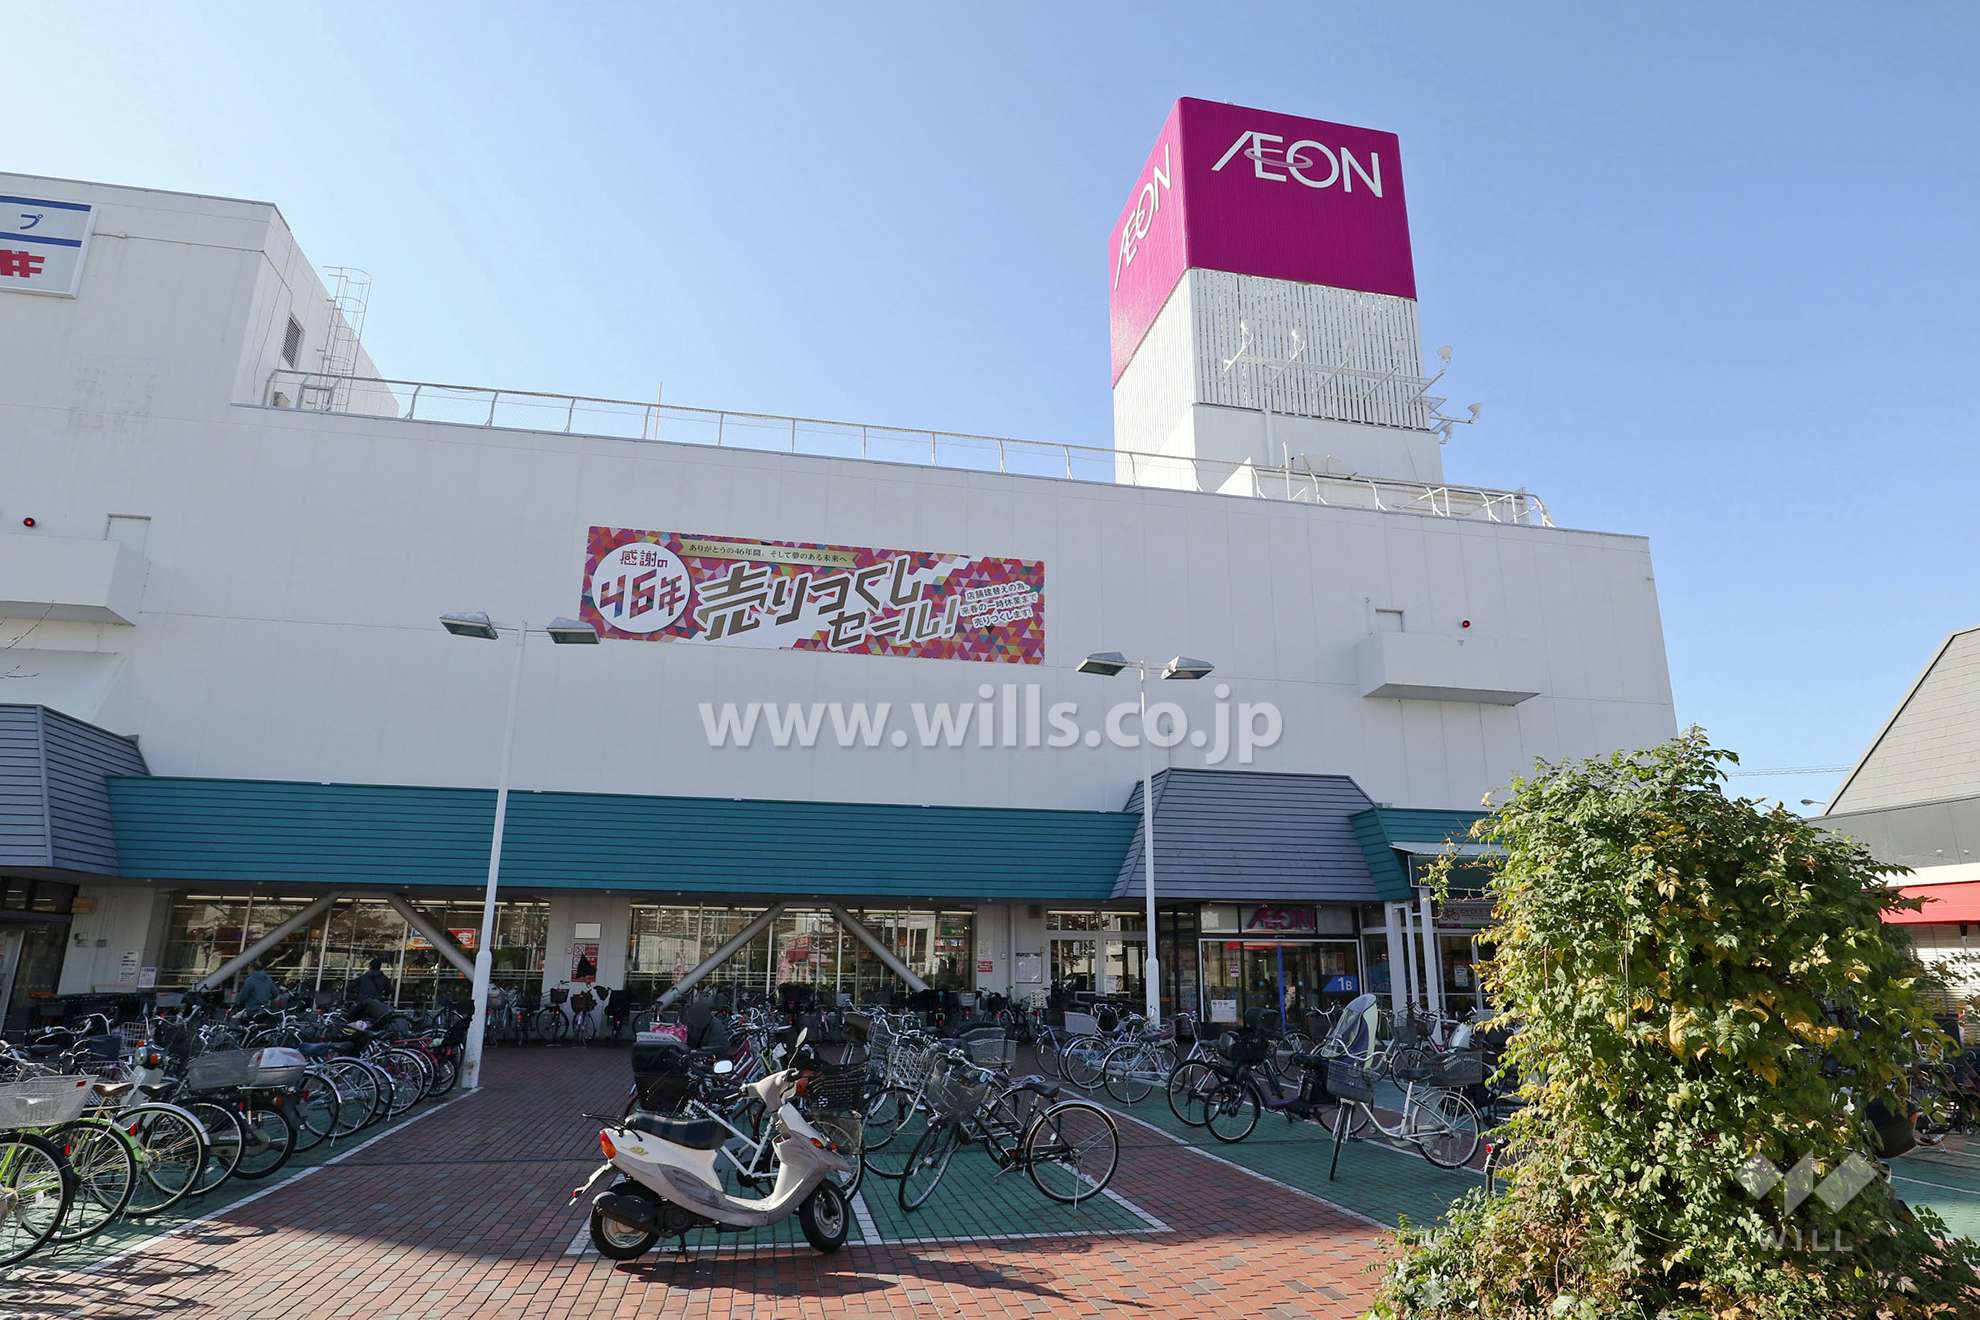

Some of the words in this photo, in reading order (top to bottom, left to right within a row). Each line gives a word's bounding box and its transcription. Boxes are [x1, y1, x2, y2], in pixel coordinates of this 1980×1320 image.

[20, 213, 43, 230] プ
[620, 549, 668, 568] 感謝の
[600, 569, 685, 619] 46年
[698, 557, 922, 641] 売りつくし
[1338, 976, 1353, 991] 1B
